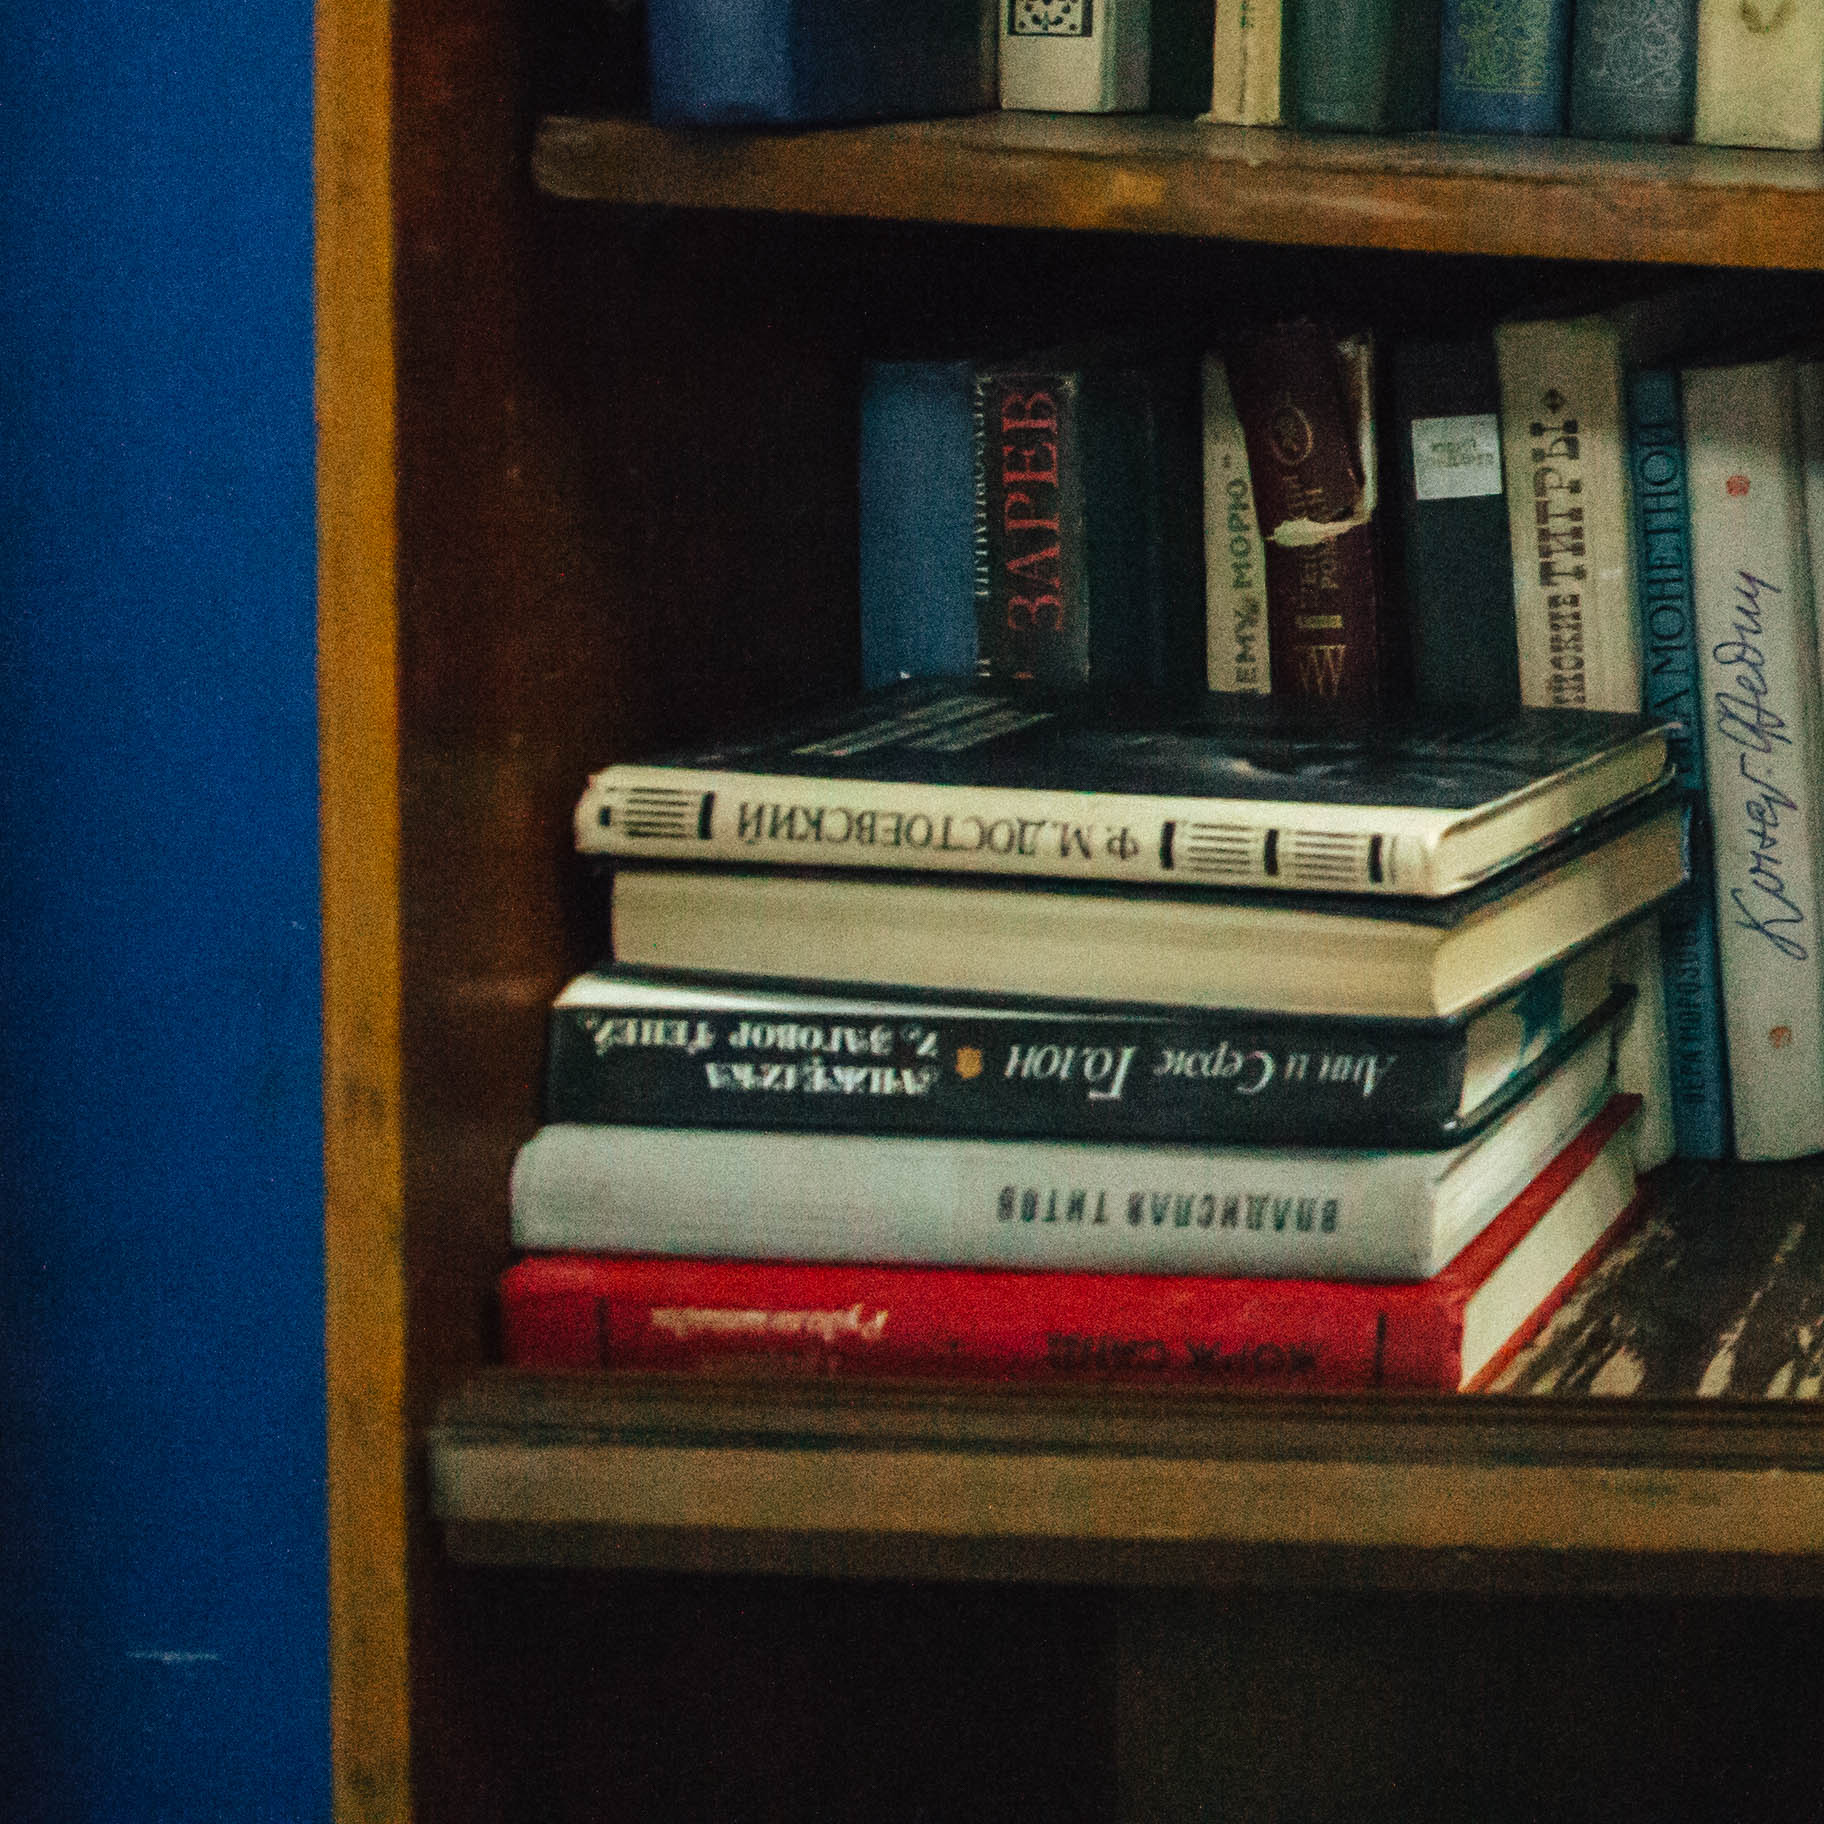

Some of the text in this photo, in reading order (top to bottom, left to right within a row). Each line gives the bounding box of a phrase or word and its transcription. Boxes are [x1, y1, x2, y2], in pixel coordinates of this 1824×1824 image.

[1001, 389, 1065, 632] ЗАРЕВ
[1529, 419, 1586, 585] ТИГРЫ
[1227, 477, 1252, 588] МОРЮ
[733, 799, 1046, 853] ДОСТОЕВСКИЙ
[726, 1019, 892, 1056] ЗАГОВОР
[1151, 1038, 1275, 1096] Серж
[998, 1040, 1137, 1101] Голон
[994, 1184, 1338, 1234] ВЛАДИСЛАВ ТИТОВ
